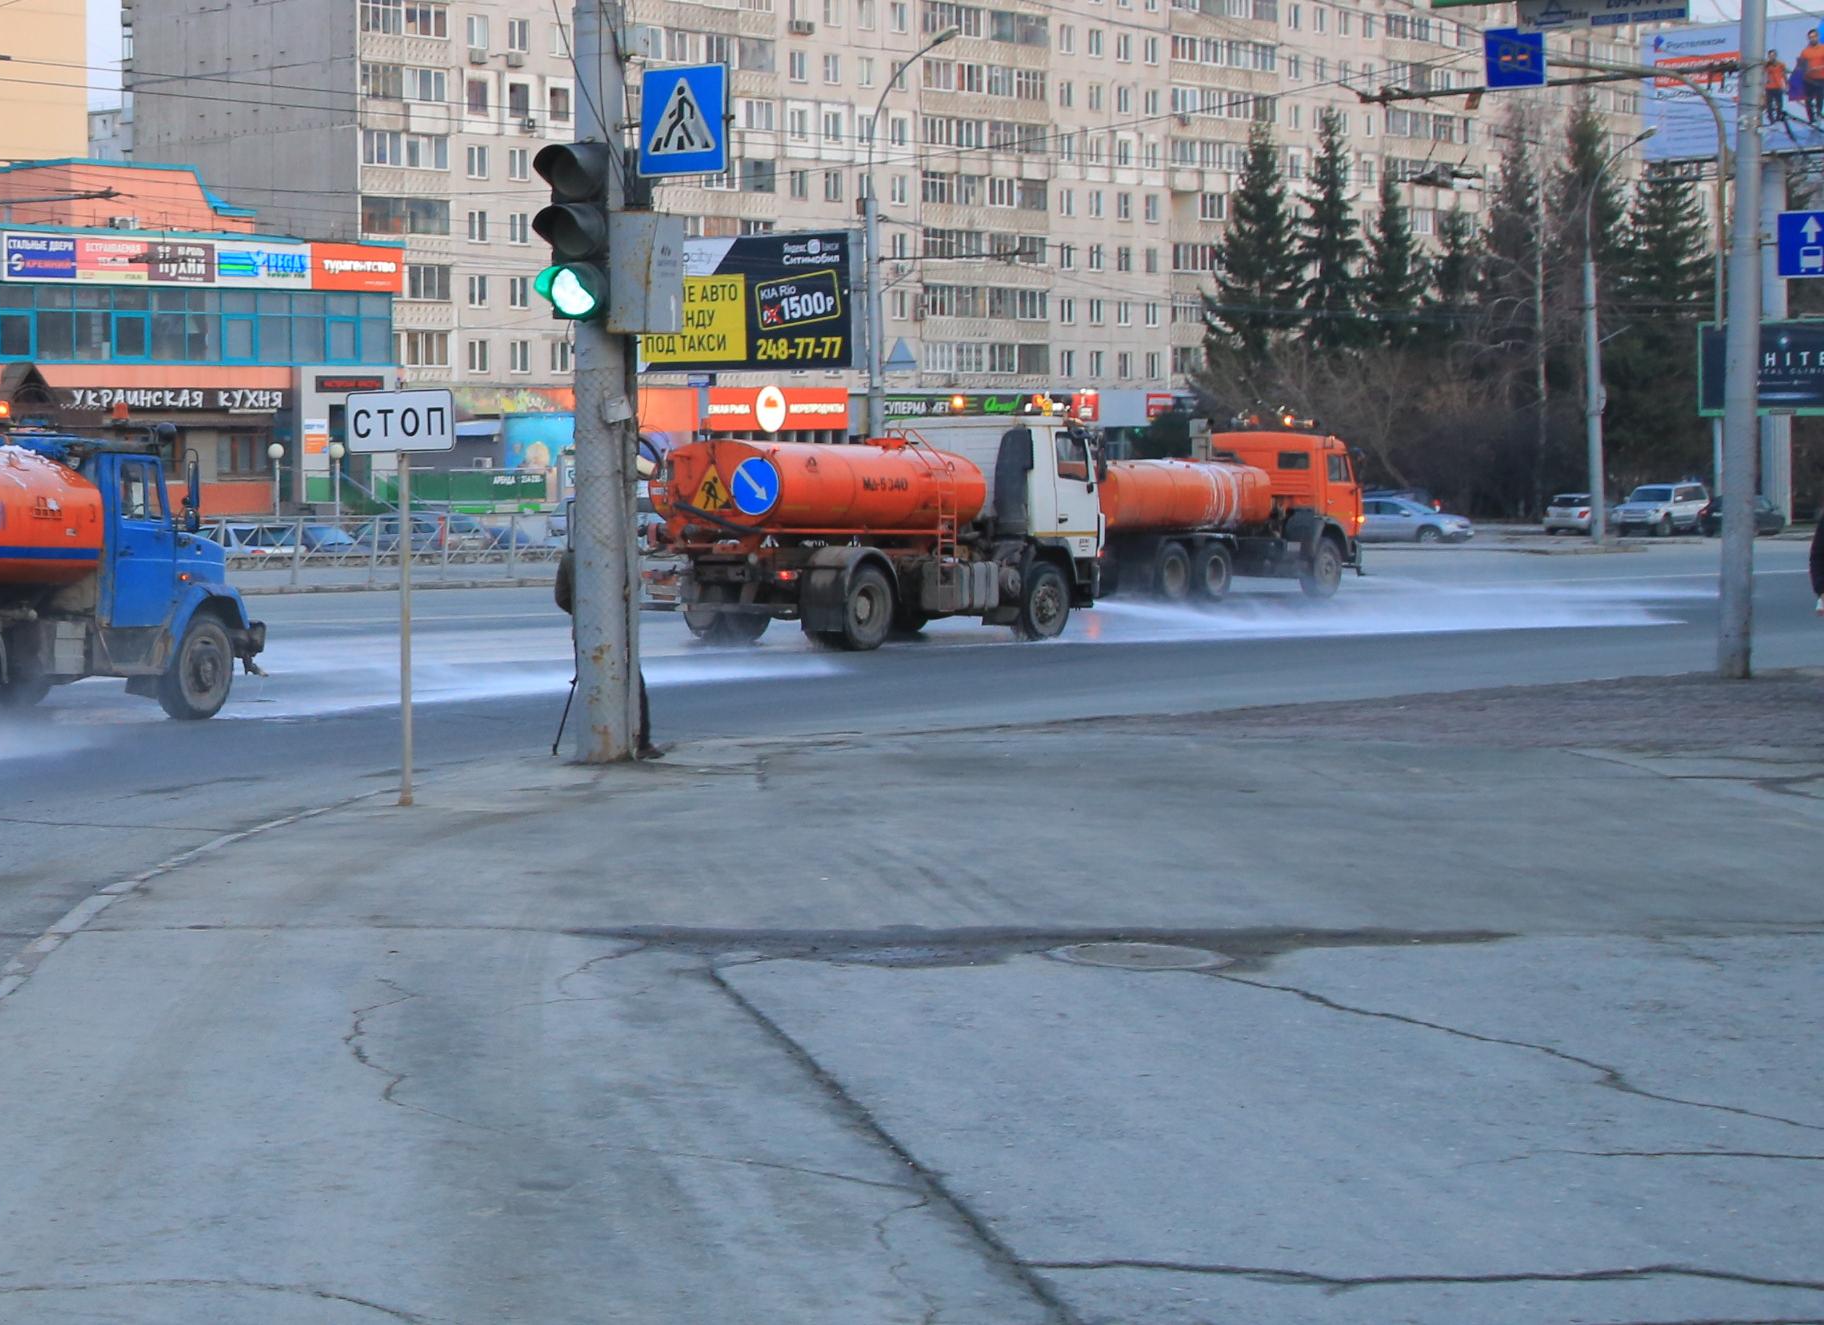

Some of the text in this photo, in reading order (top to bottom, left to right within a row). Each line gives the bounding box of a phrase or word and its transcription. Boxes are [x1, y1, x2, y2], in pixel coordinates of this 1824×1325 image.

[8, 239, 74, 252] СТАЛЬНЫЕ ДВЕРИ
[322, 259, 397, 275] турагентство
[783, 253, 840, 266] Ситимобил
[702, 283, 738, 302] АВТО
[760, 285, 796, 300] KIA Rio
[646, 334, 726, 355] ПОД ТАКСИ
[756, 336, 842, 361] 248-77-77
[73, 389, 283, 409] УКРАИНСКАЯ КУХНЯ
[353, 407, 445, 438] СТОП
